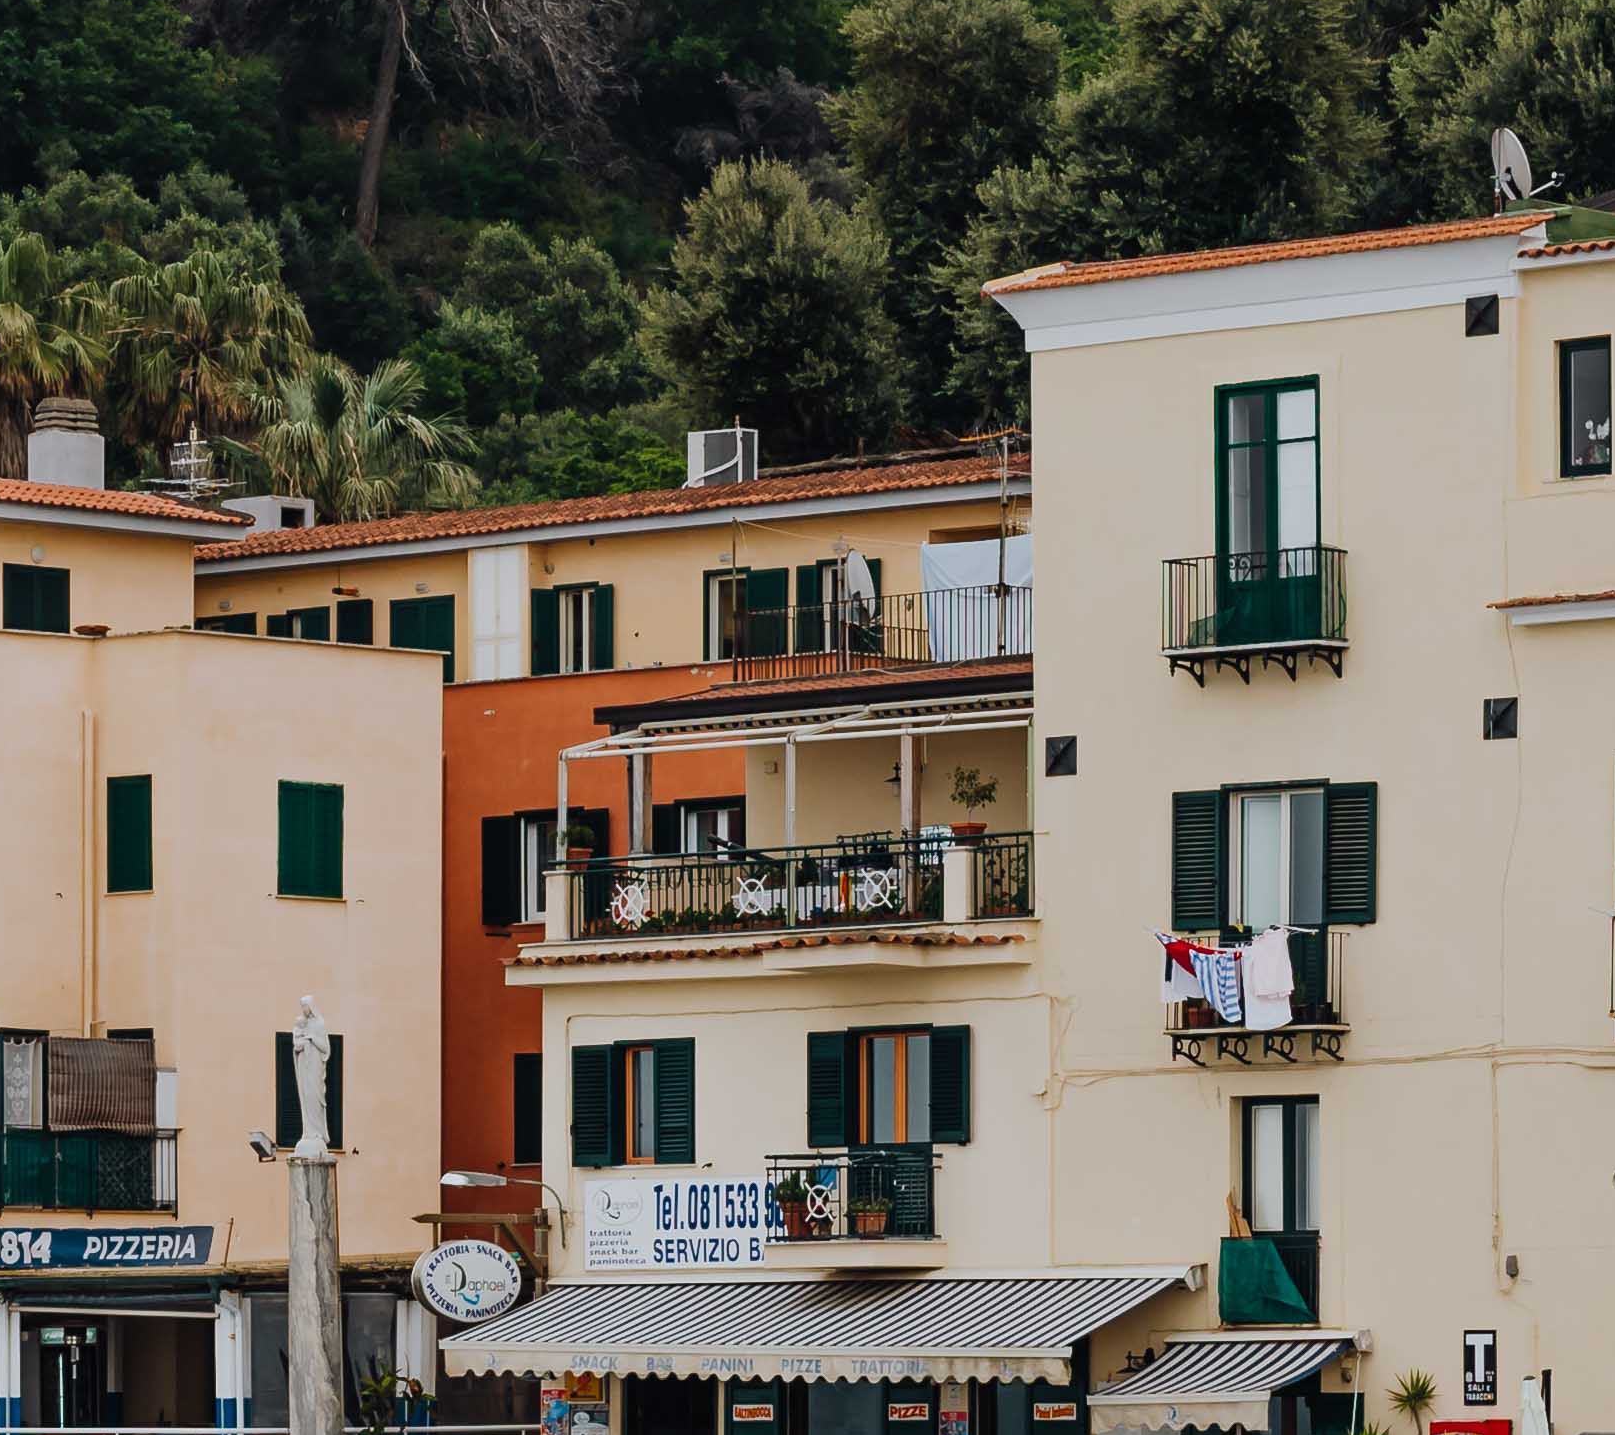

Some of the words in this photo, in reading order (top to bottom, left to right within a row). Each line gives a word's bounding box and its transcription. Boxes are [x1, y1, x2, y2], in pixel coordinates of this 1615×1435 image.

[83, 1234, 196, 1260] PIZZERIA
[589, 1238, 629, 1247] pizzeria
[589, 1248, 618, 1256] snack
[621, 1247, 639, 1255] bar
[653, 1238, 740, 1264] SERVIZIO
[427, 1245, 470, 1278] TRATTORIA
[476, 1245, 503, 1263] SNACK
[505, 1260, 518, 1284] BAR
[589, 1257, 647, 1266] paninoteca
[426, 1283, 458, 1315] PIZZERIA
[465, 1292, 515, 1318] PANINOTECA
[571, 1355, 619, 1370] SNACK
[702, 1358, 754, 1373] PANINI
[781, 1358, 822, 1374] PIZZE
[851, 1359, 929, 1374] TRATTORIA
[890, 1406, 927, 1418] PIZZE
